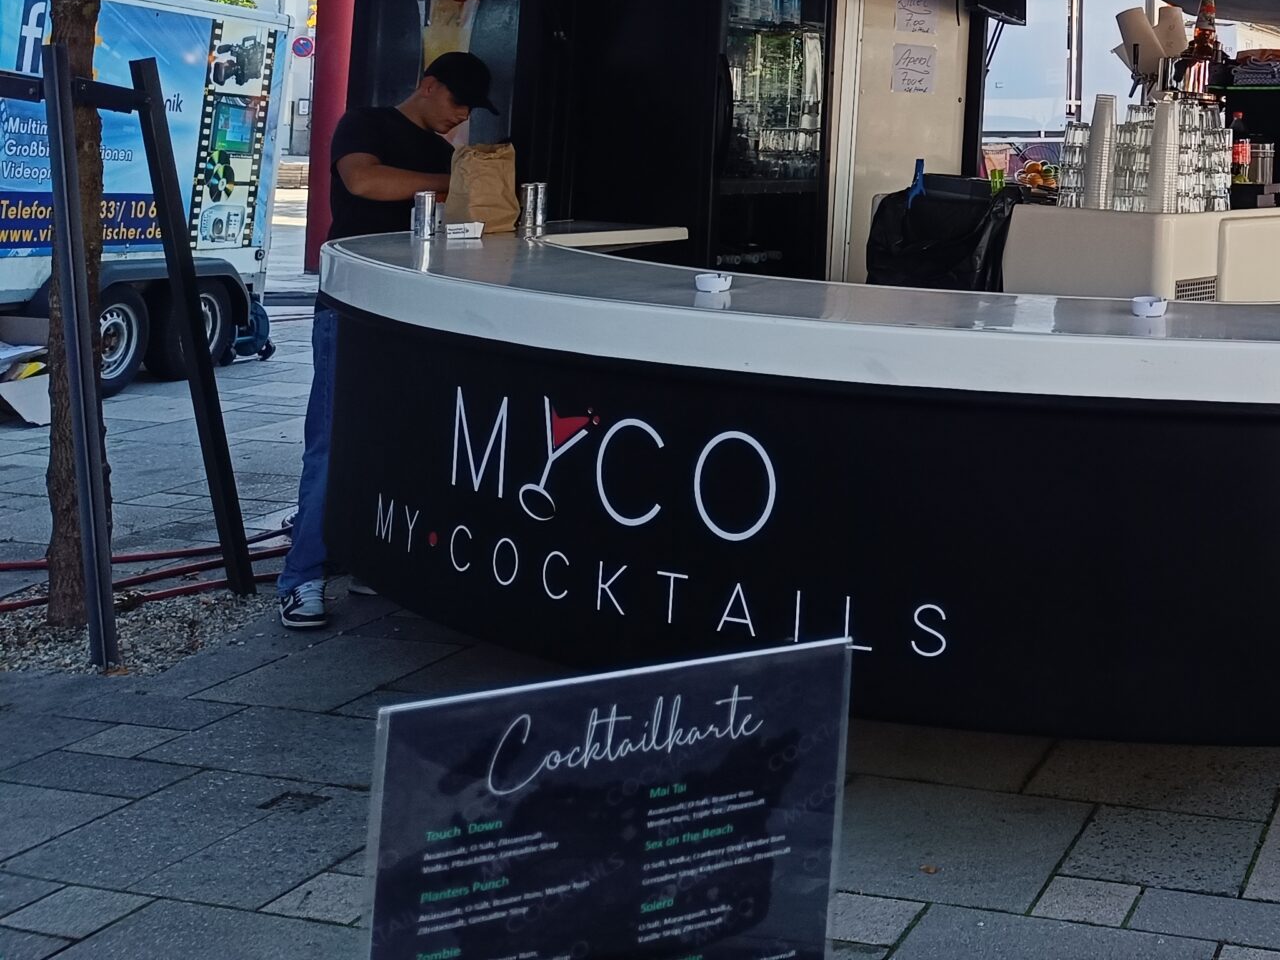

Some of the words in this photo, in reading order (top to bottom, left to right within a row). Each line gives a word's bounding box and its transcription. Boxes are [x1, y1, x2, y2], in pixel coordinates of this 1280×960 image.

[451, 386, 776, 541] MYCO
[487, 684, 764, 796] Cocktailkarte
[649, 786, 670, 798] Mai
[426, 826, 461, 843] Touch
[468, 820, 503, 835] Down
[644, 840, 663, 851] Sex
[665, 836, 680, 847] on
[682, 831, 701, 843] the
[702, 824, 734, 839] Beach
[420, 886, 470, 905] Planters
[472, 877, 509, 893] Punch
